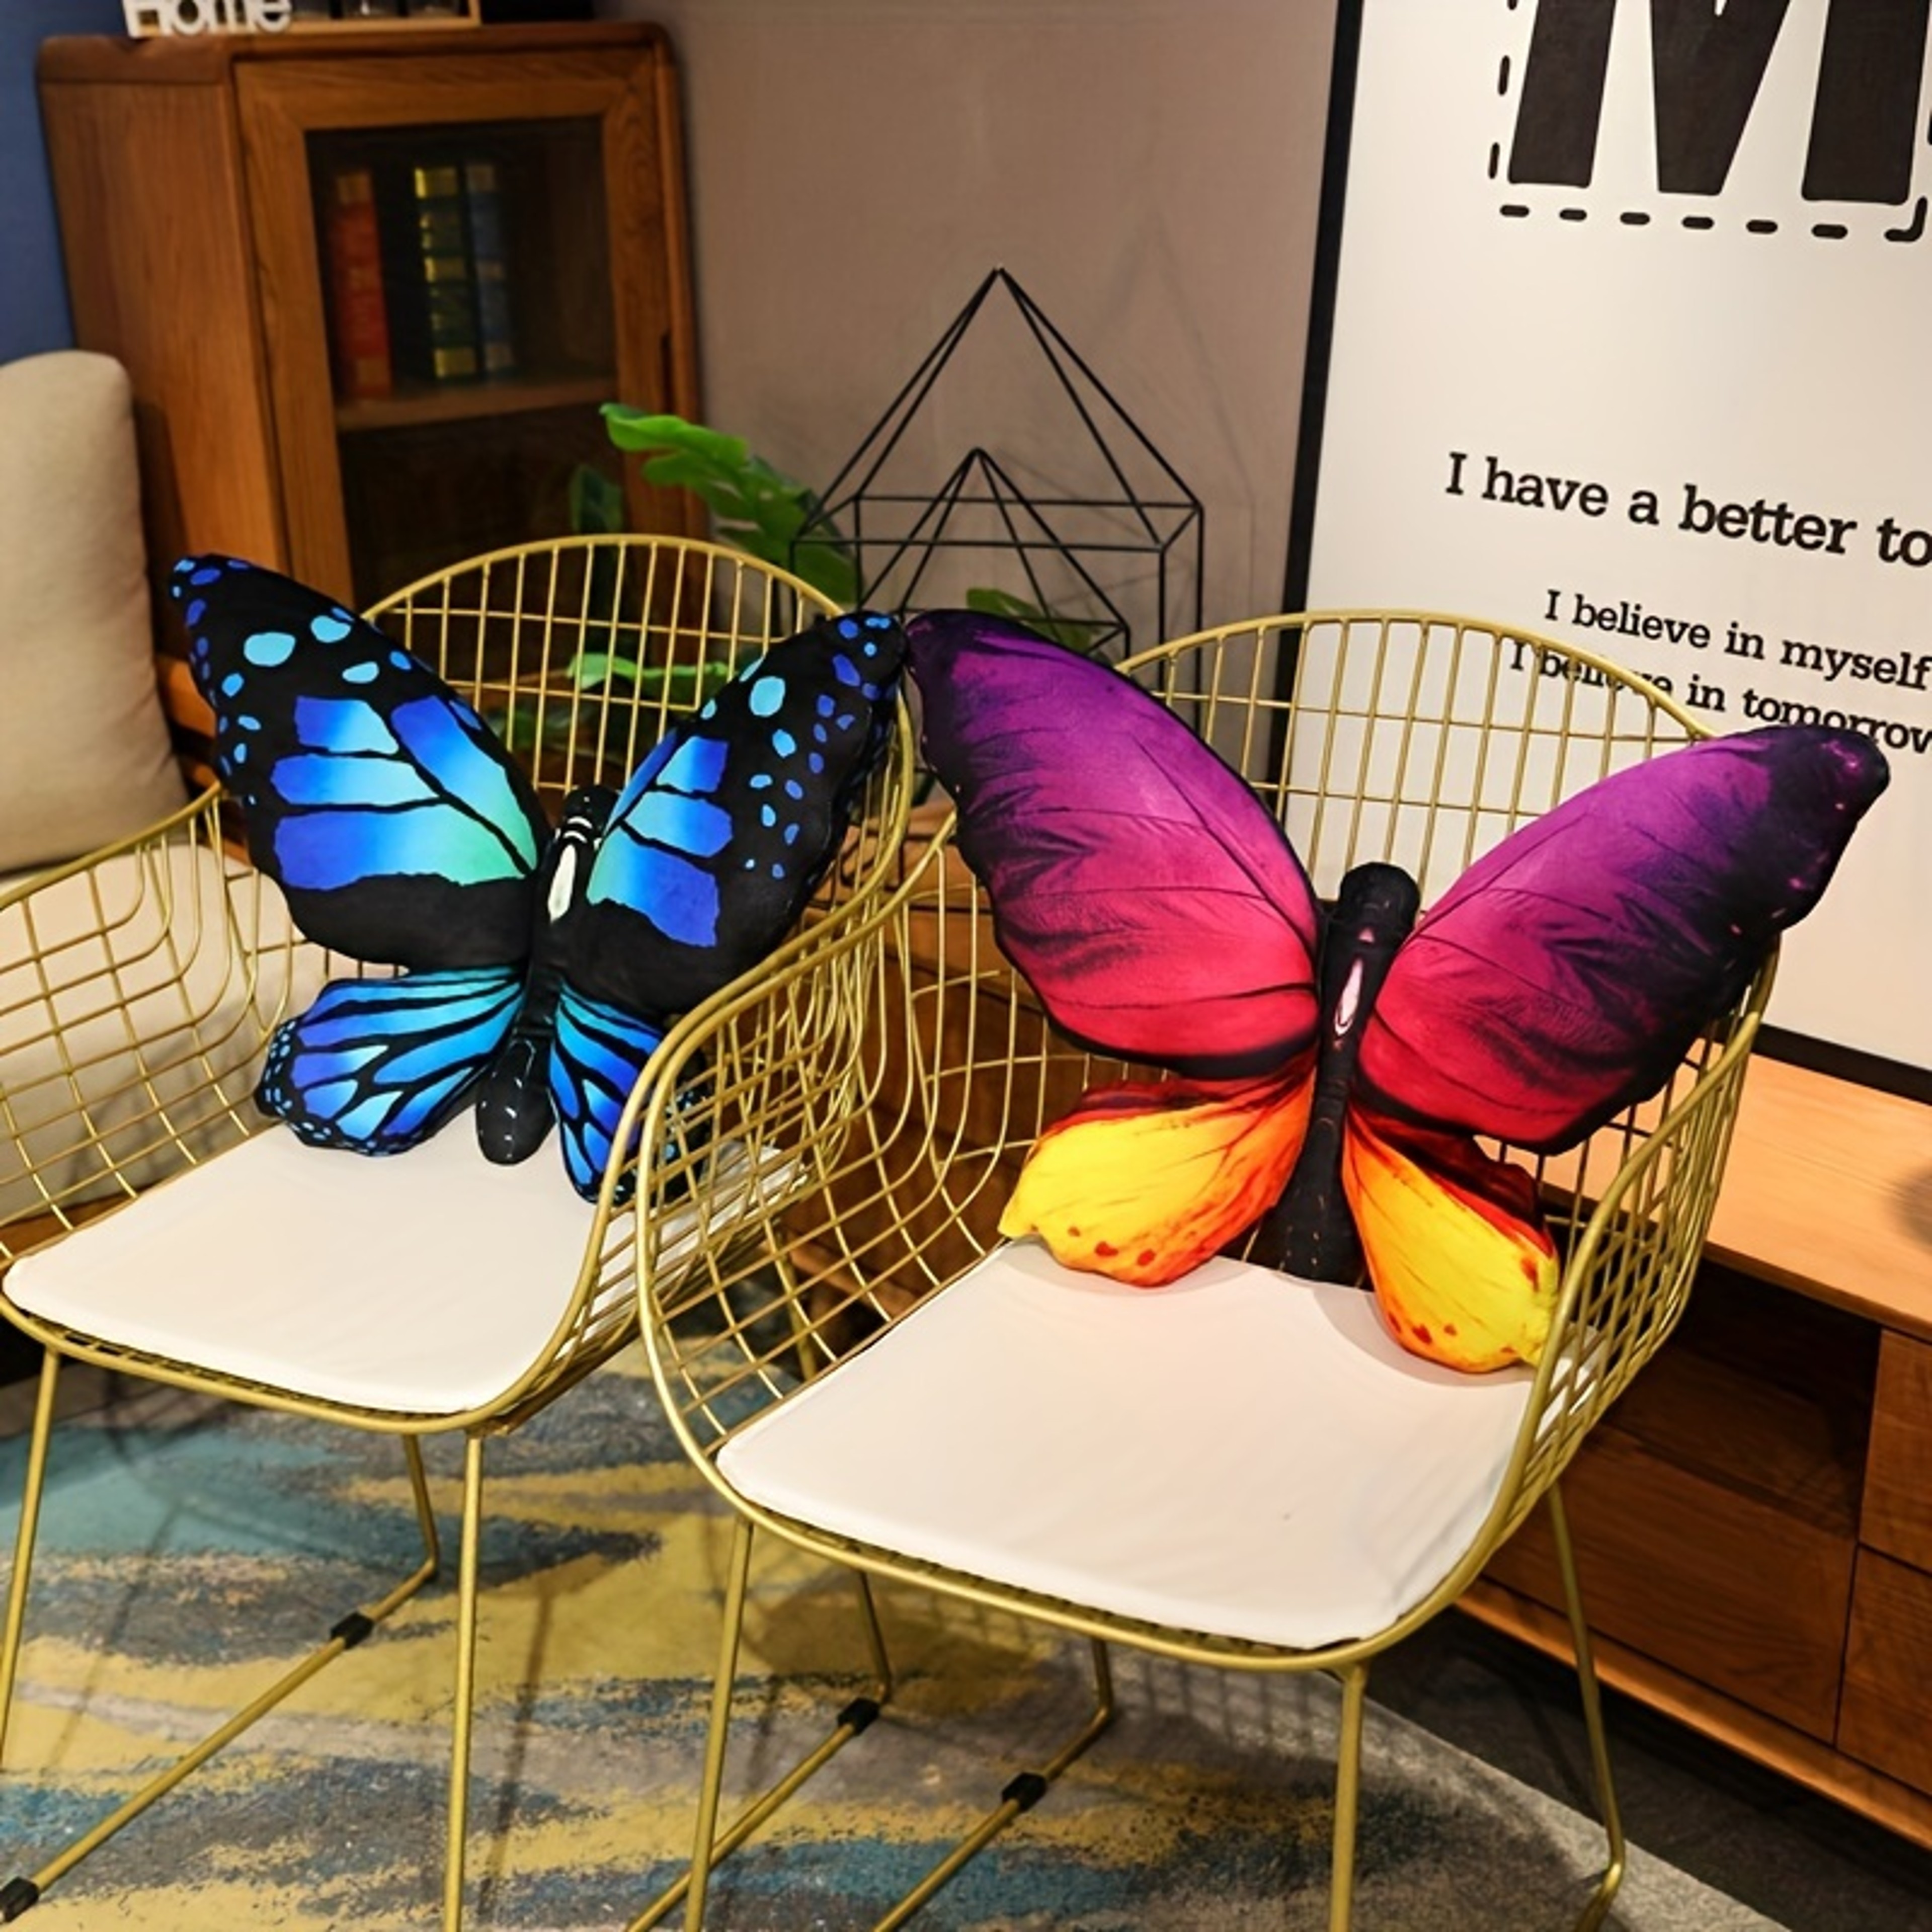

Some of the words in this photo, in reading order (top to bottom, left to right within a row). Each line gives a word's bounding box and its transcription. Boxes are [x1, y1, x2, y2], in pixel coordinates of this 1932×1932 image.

[1445, 451, 1467, 496] I
[1482, 456, 1609, 517] have
[1628, 490, 1660, 526] a
[1678, 484, 1858, 554] better
[1510, 638, 1529, 671] I
[1685, 674, 1726, 712] in
[1545, 589, 1561, 621] I
[1571, 593, 1711, 649] believe
[1723, 621, 1765, 660] in
[1780, 639, 1932, 691] myself
